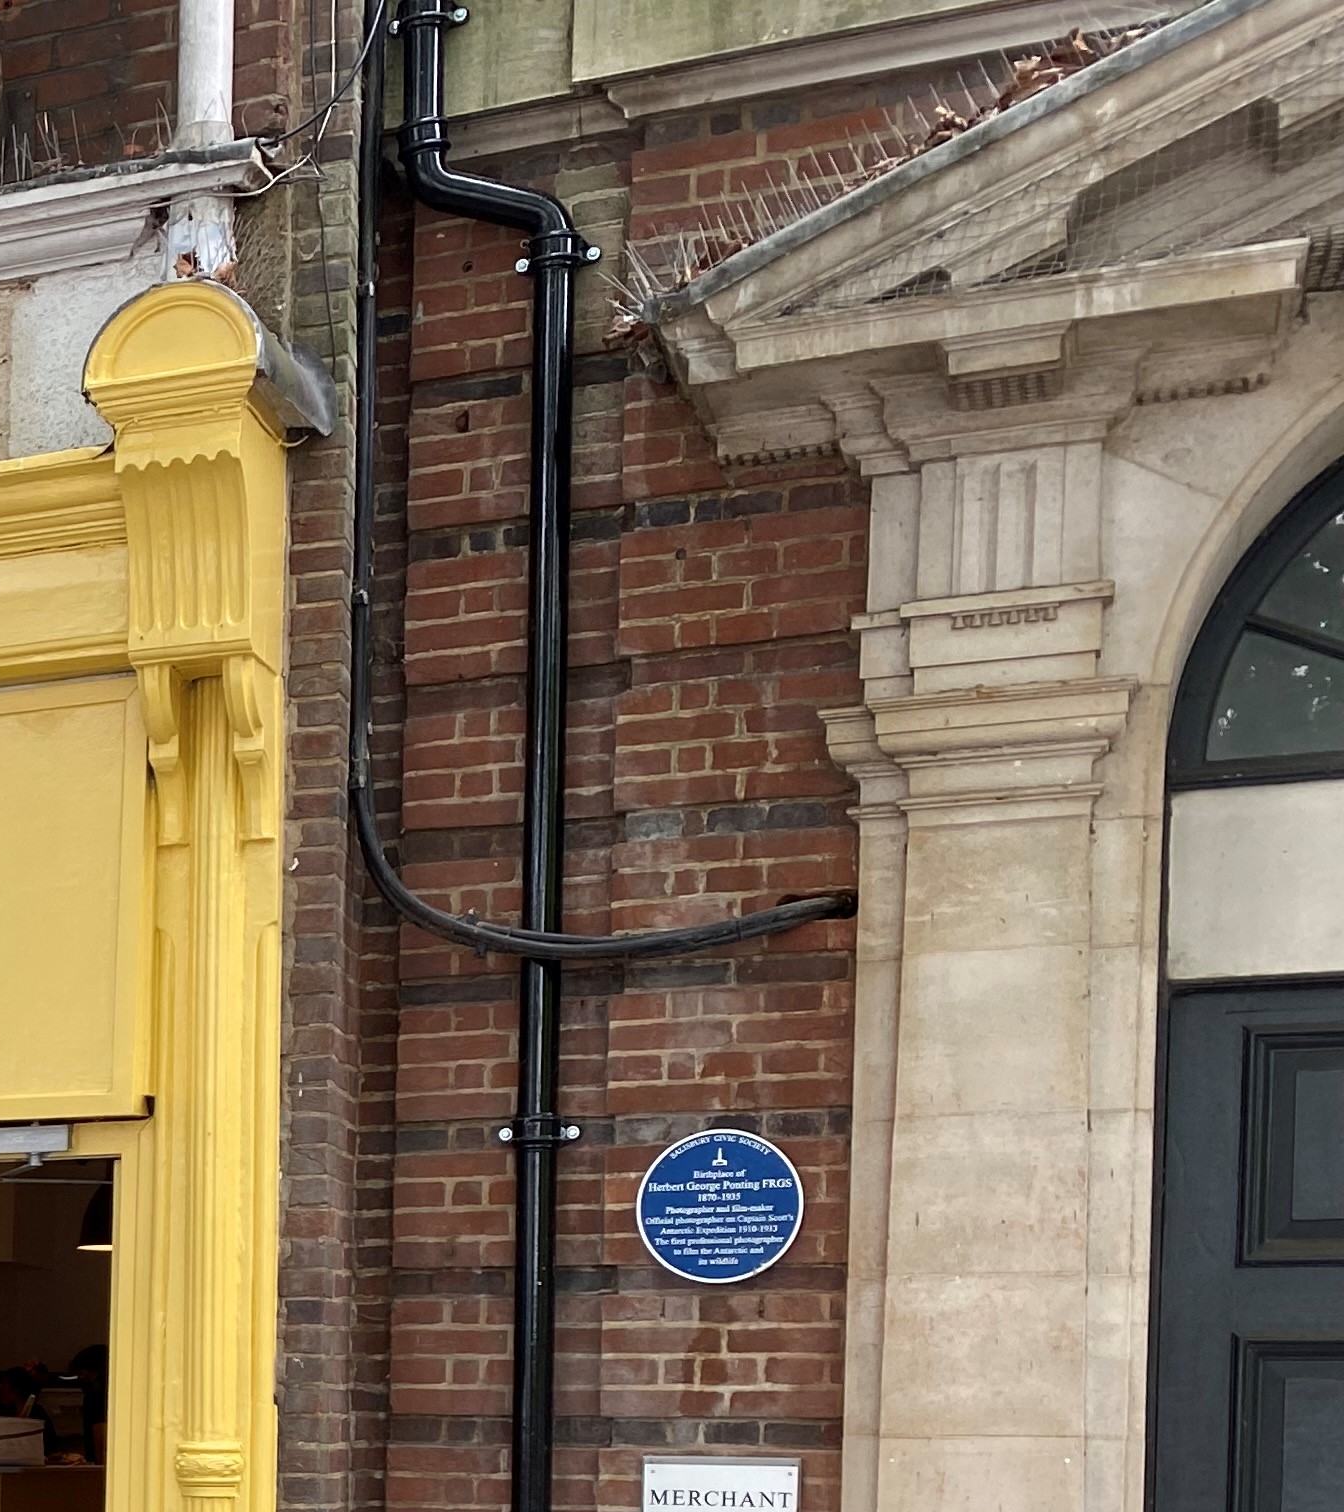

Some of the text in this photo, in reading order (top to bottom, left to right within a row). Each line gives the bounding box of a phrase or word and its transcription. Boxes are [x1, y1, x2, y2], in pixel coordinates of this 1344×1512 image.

[669, 1136, 711, 1160] SALISBURY
[739, 1137, 771, 1156] SOCIETY
[693, 1169, 747, 1179] Birthplace of
[649, 1178, 792, 1192] Herbert George Ponting FRGS
[698, 1193, 740, 1202] 1870-1935
[666, 1206, 714, 1215] Photographer
[737, 1215, 766, 1223] Captain
[696, 1227, 736, 1236] Expedition
[650, 1488, 793, 1510] MERCHANT
